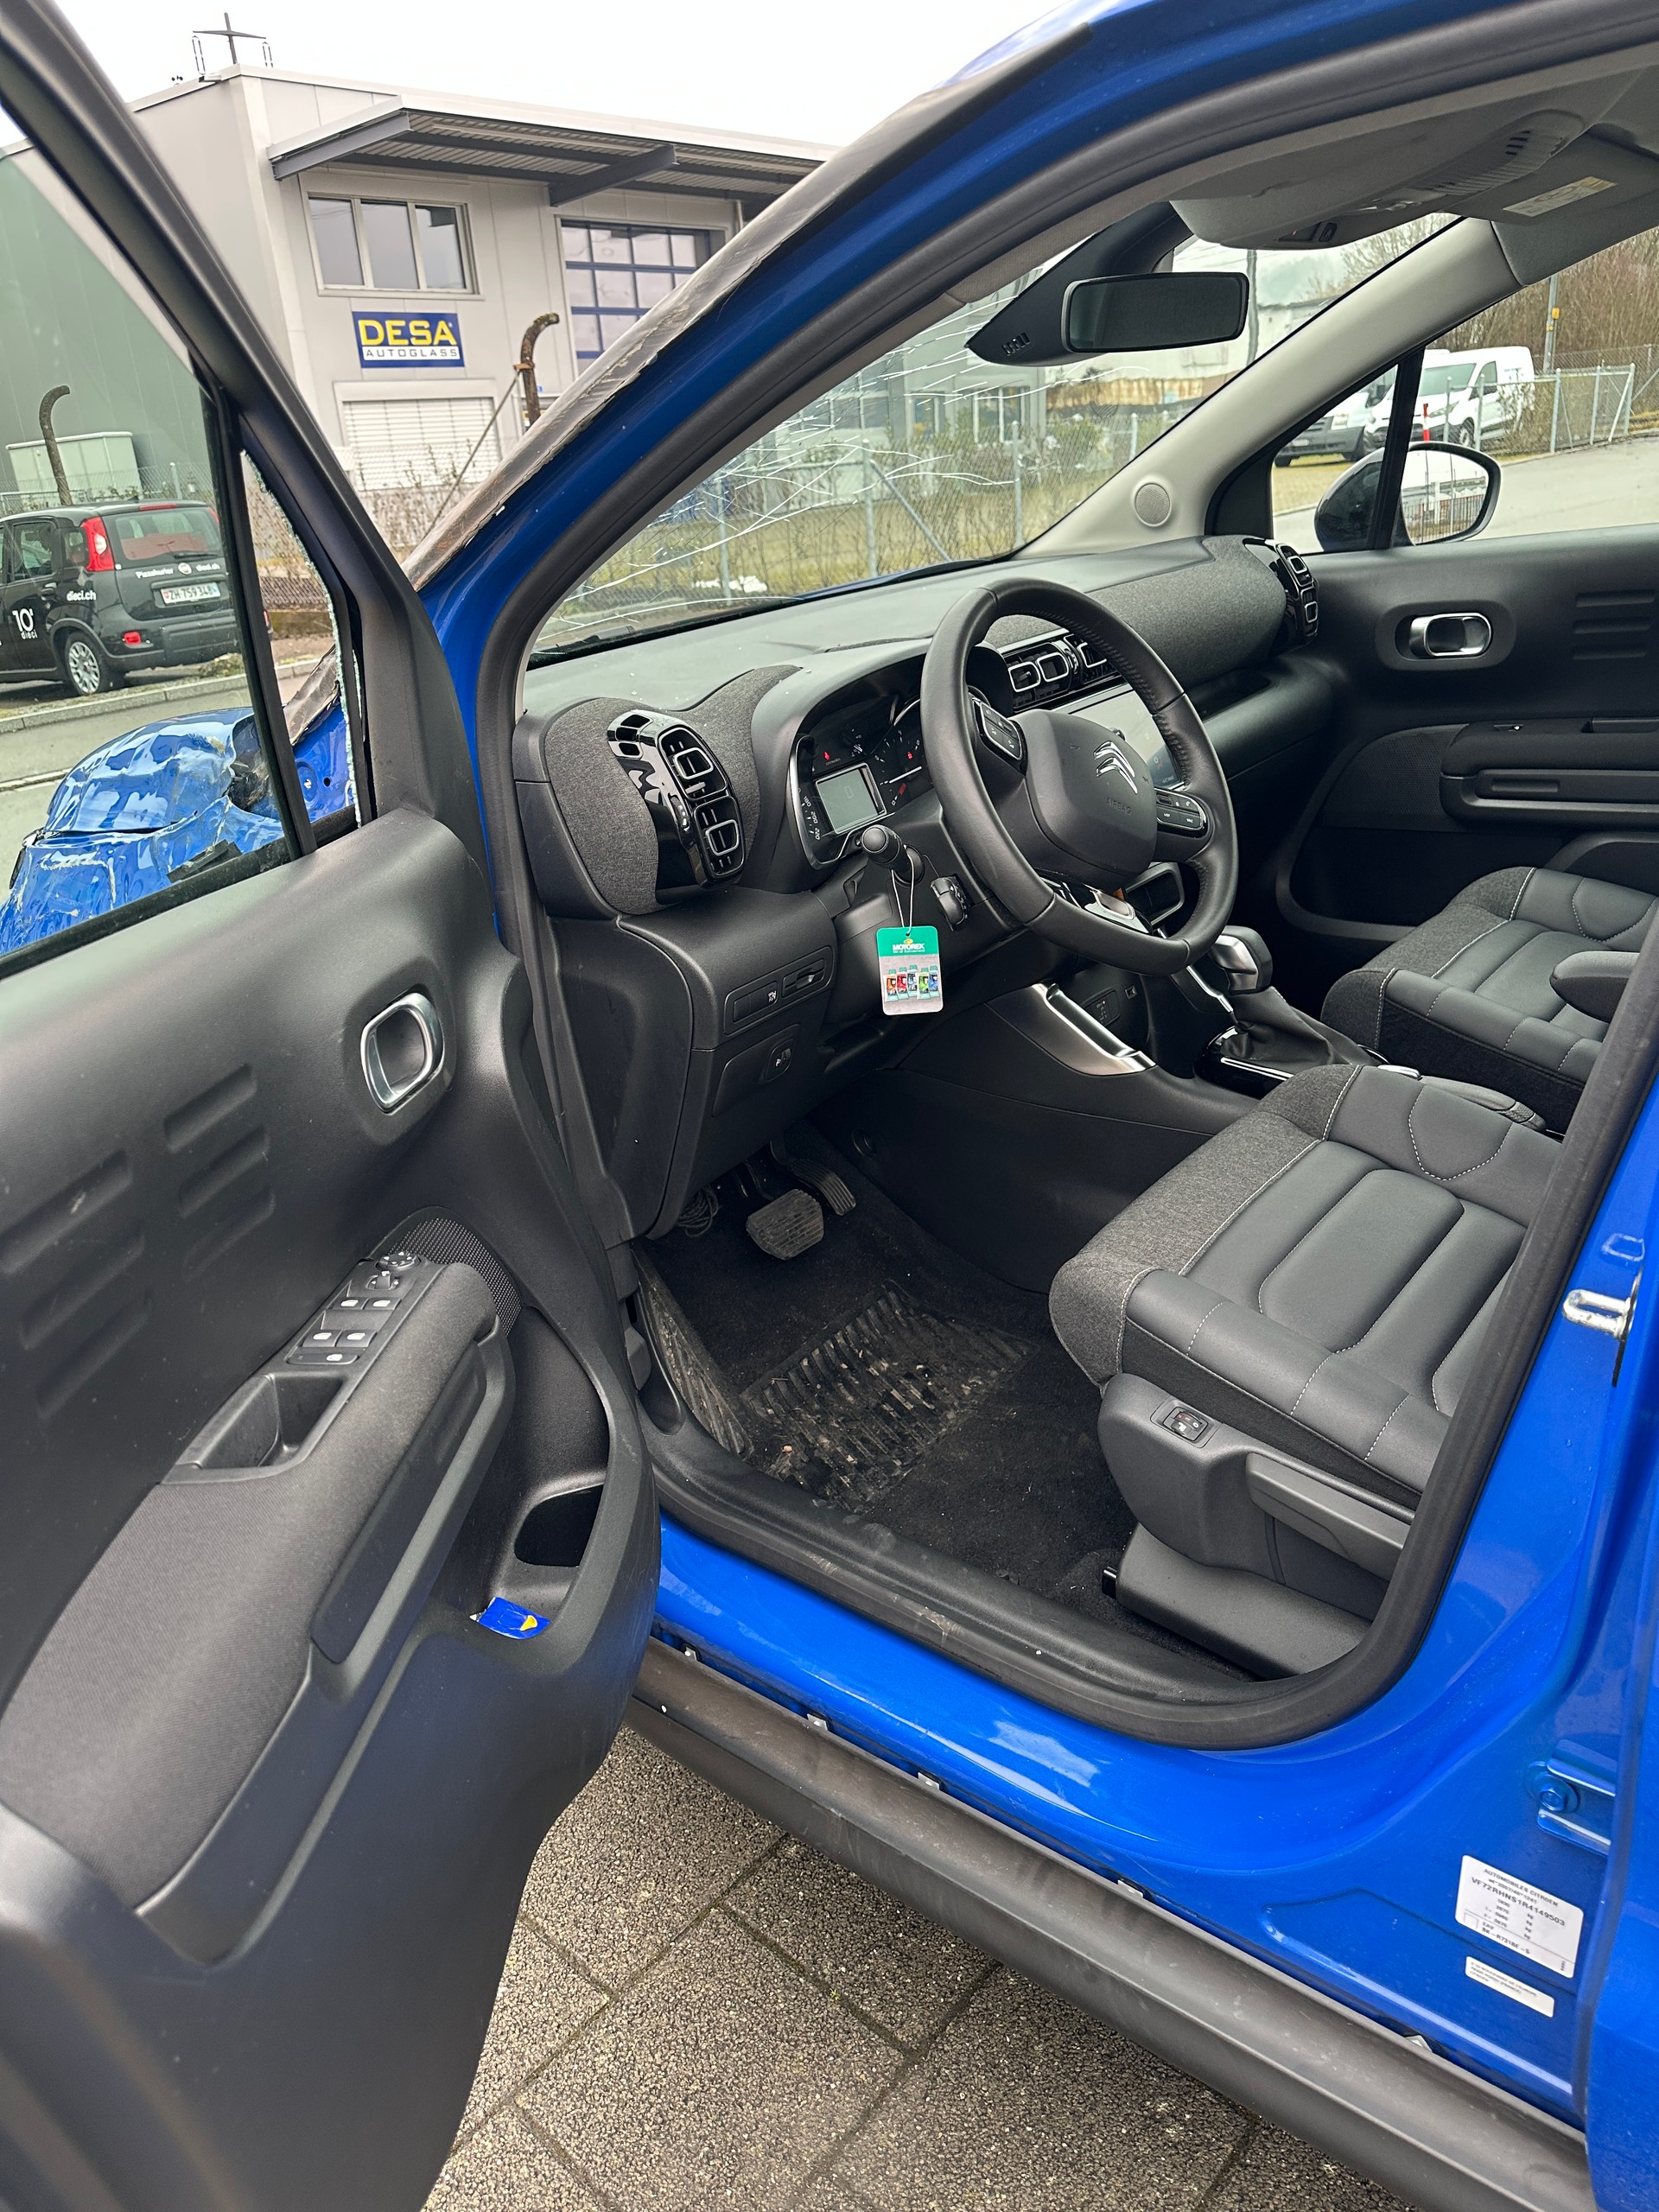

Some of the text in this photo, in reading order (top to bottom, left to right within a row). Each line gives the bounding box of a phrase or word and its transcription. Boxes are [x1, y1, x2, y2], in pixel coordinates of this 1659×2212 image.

[358, 319, 457, 346] DESA
[366, 348, 457, 358] AUTOGLASS
[67, 590, 97, 601] dieci.ch
[21, 629, 38, 639] dieci
[1106, 797, 1132, 816] AIRBAG
